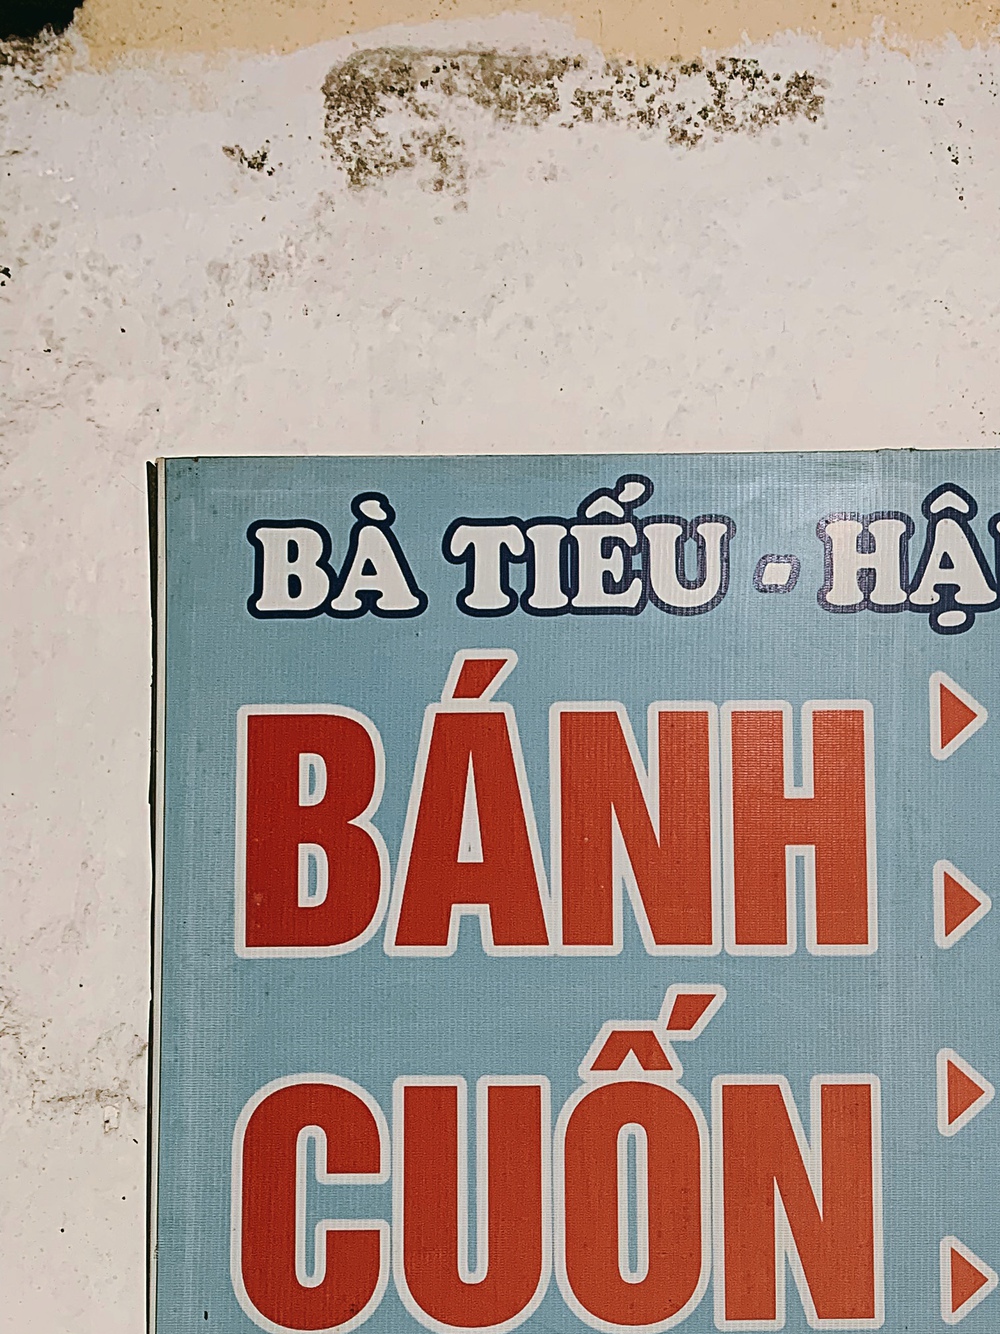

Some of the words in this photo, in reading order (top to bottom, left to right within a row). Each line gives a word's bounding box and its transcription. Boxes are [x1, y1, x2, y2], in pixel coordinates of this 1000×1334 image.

[250, 491, 427, 620] BÀ
[444, 474, 736, 616] TIẾU
[236, 650, 878, 960] BÁNH
